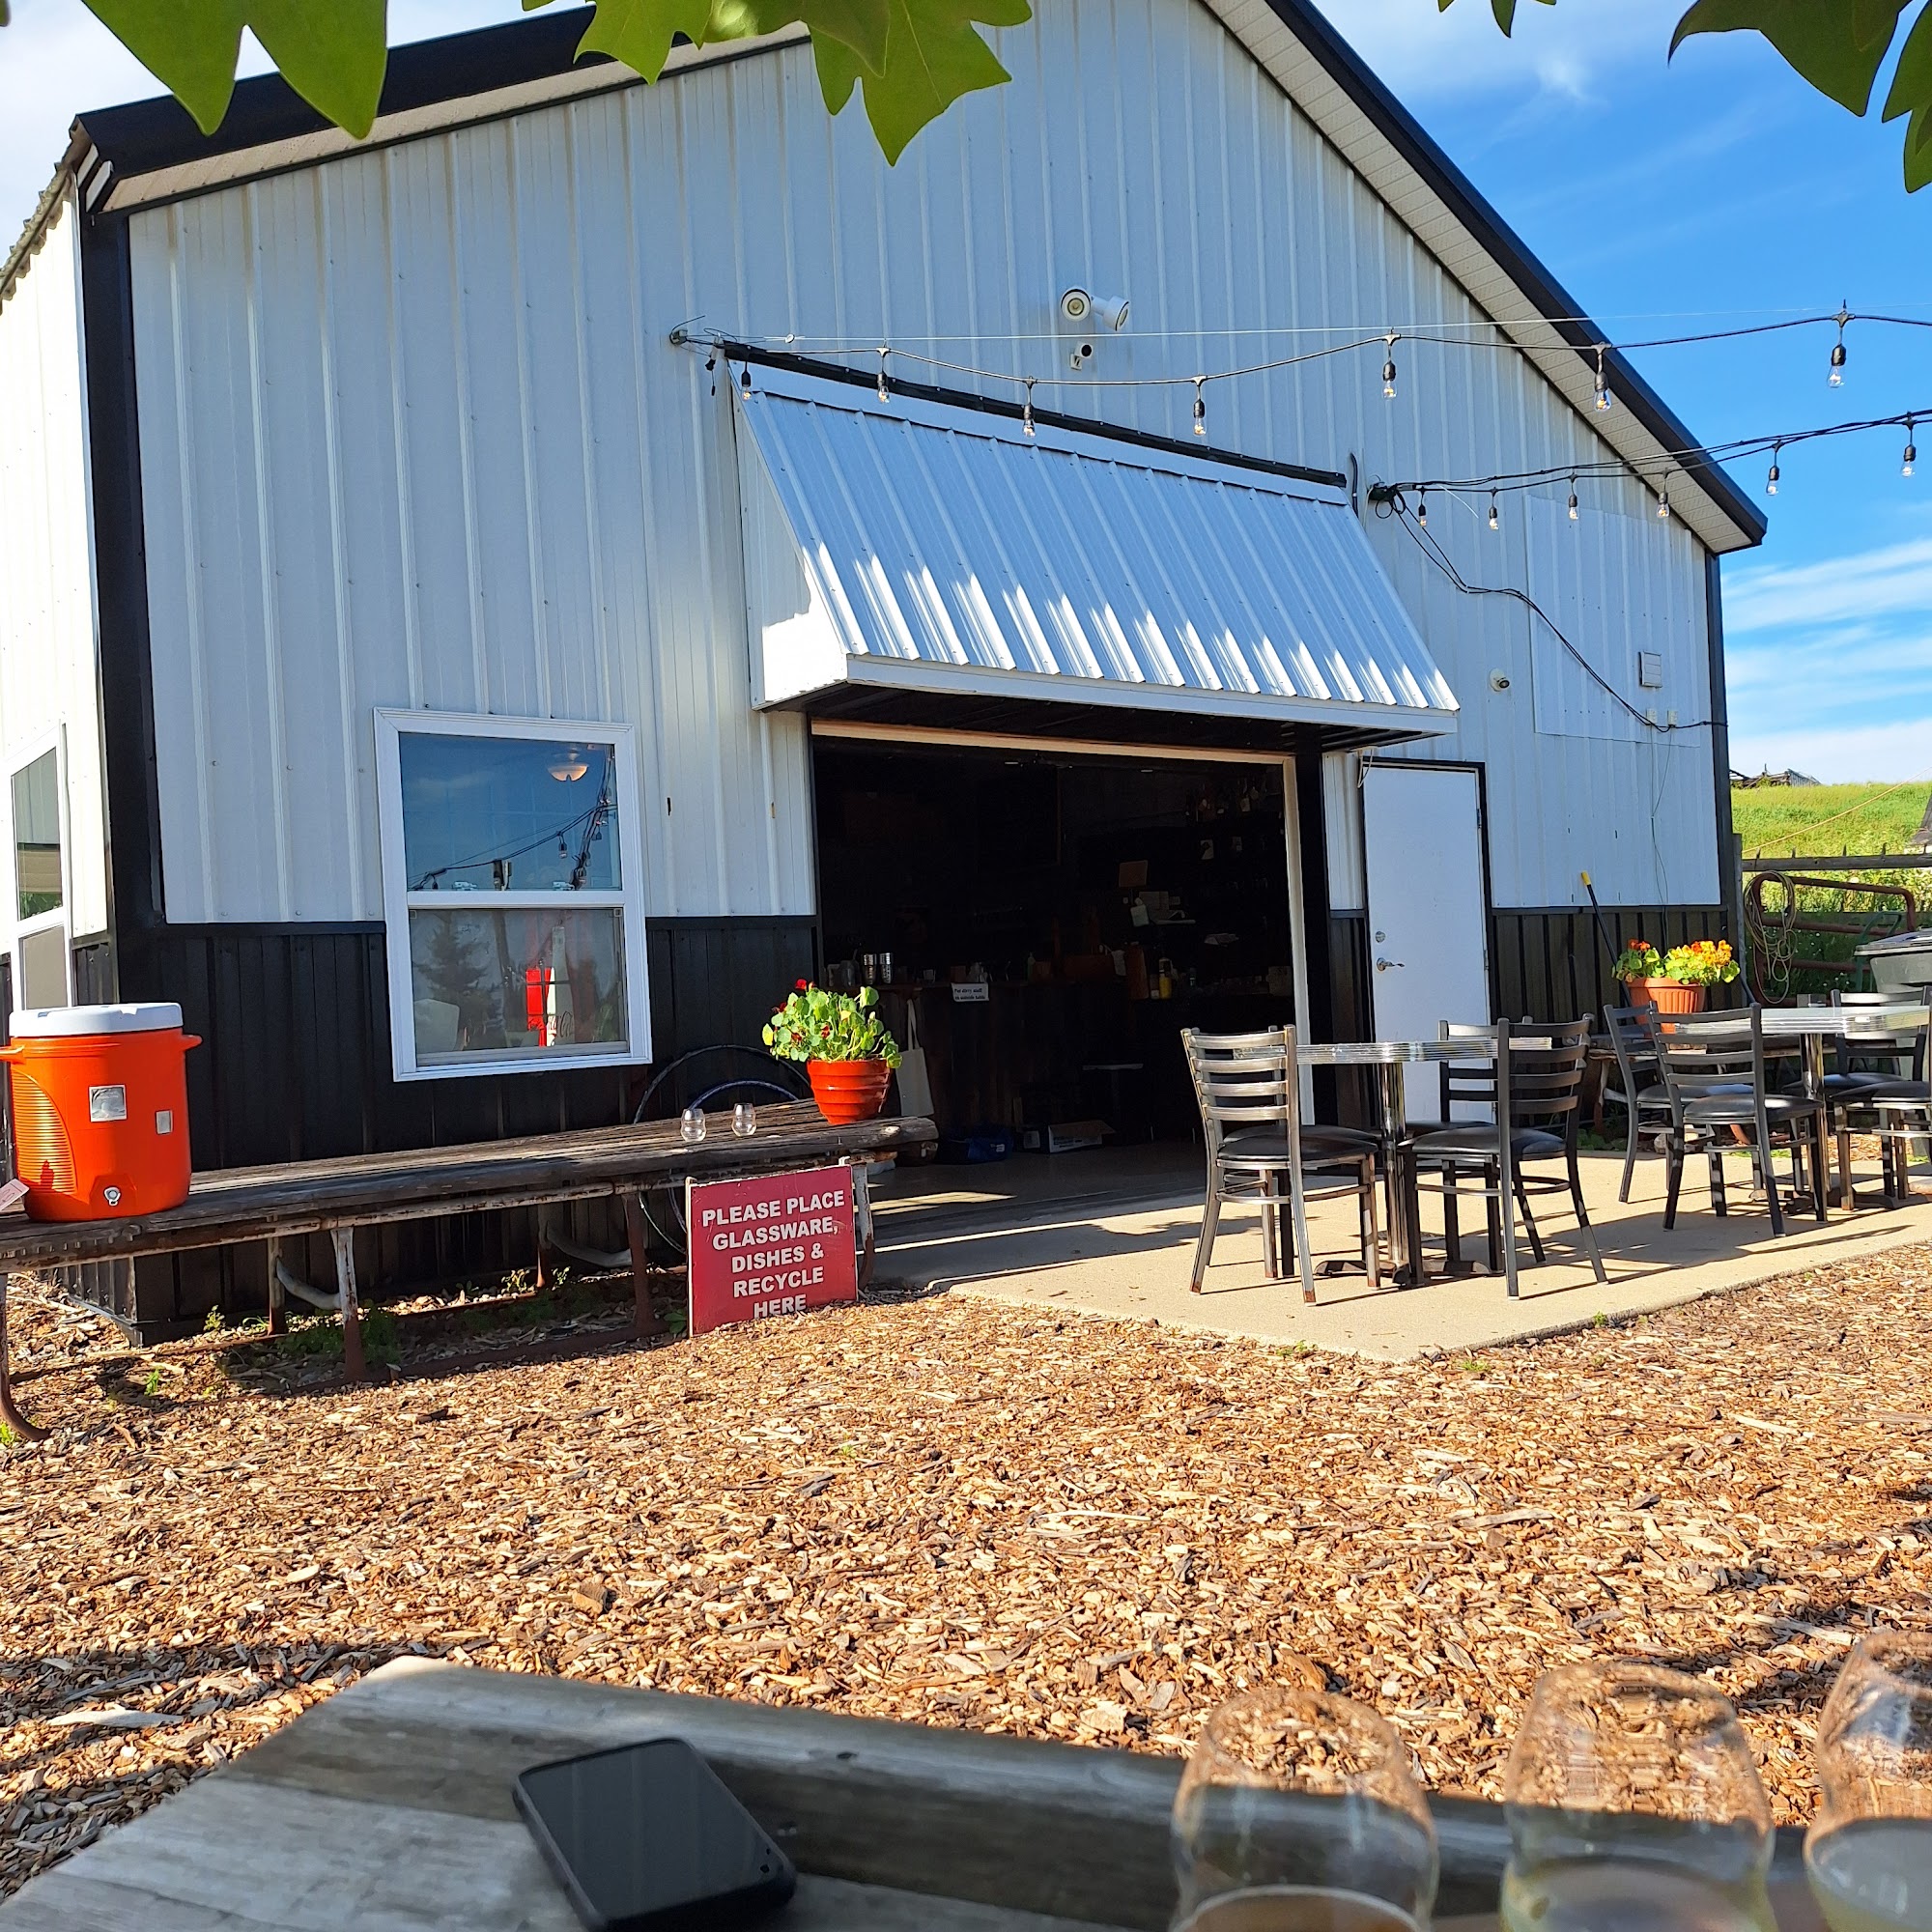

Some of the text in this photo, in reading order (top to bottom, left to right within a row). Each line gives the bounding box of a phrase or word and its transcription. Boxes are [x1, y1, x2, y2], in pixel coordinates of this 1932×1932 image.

[702, 1190, 845, 1227] PLEASE PLACE
[712, 1216, 838, 1251] GLASSWARE,
[731, 1242, 824, 1273] DISHES &
[733, 1266, 824, 1298] RECYCLE
[753, 1293, 807, 1320] HERE
